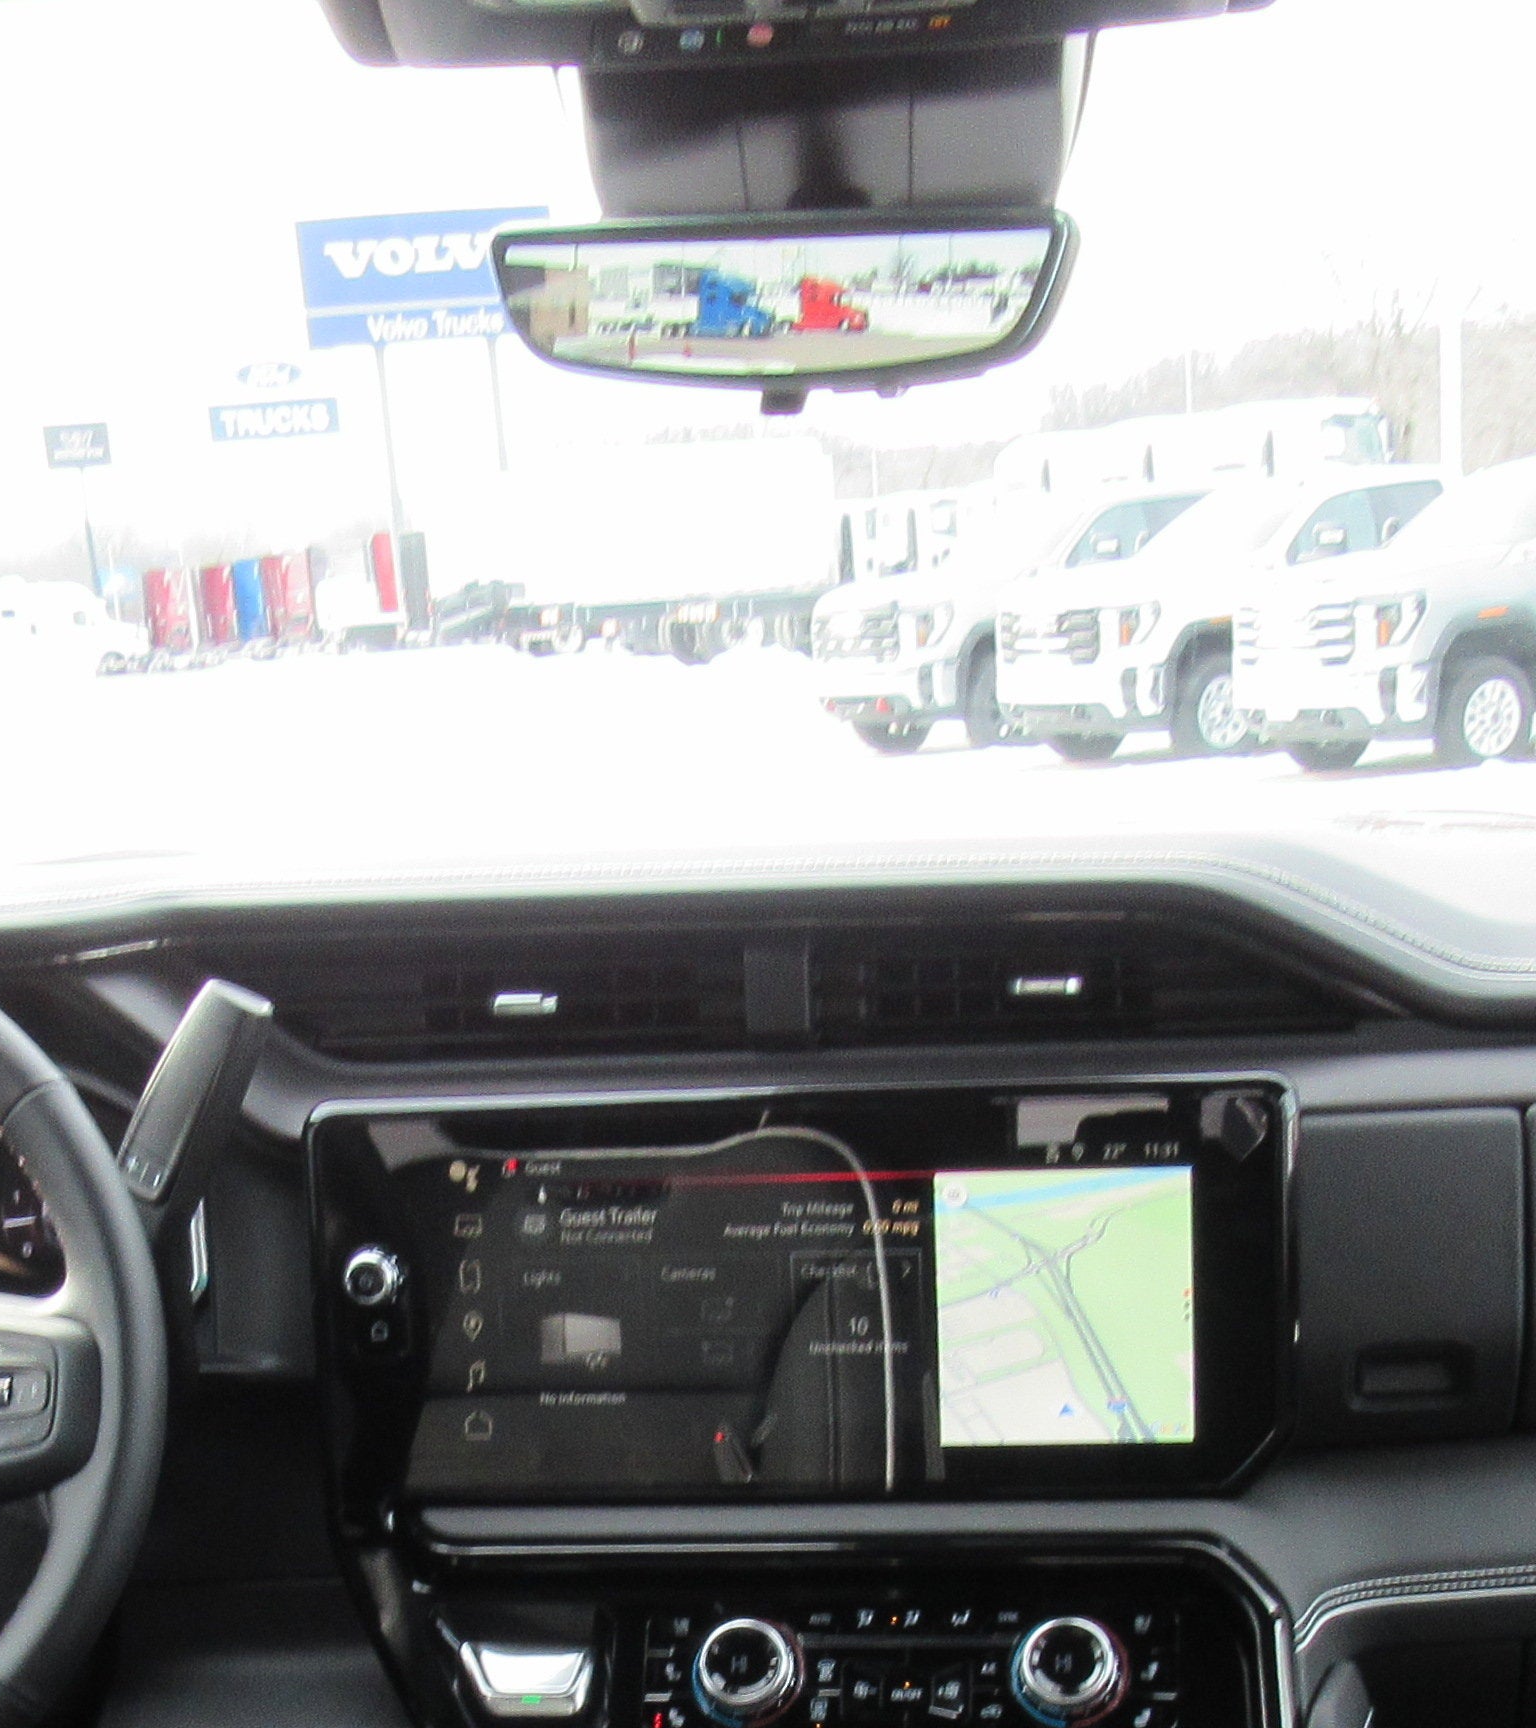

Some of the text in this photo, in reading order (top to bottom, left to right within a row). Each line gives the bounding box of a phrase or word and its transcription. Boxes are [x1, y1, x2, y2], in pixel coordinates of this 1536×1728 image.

[323, 231, 491, 280] VOLV
[367, 305, 505, 343] Volvo Trucks
[219, 403, 331, 438] TRUCKS
[560, 1205, 658, 1229] Guest Trailer
[806, 1200, 855, 1219] Mileage
[723, 1221, 772, 1240] Average
[773, 1219, 799, 1238] Fuel
[800, 1219, 856, 1238] Economy
